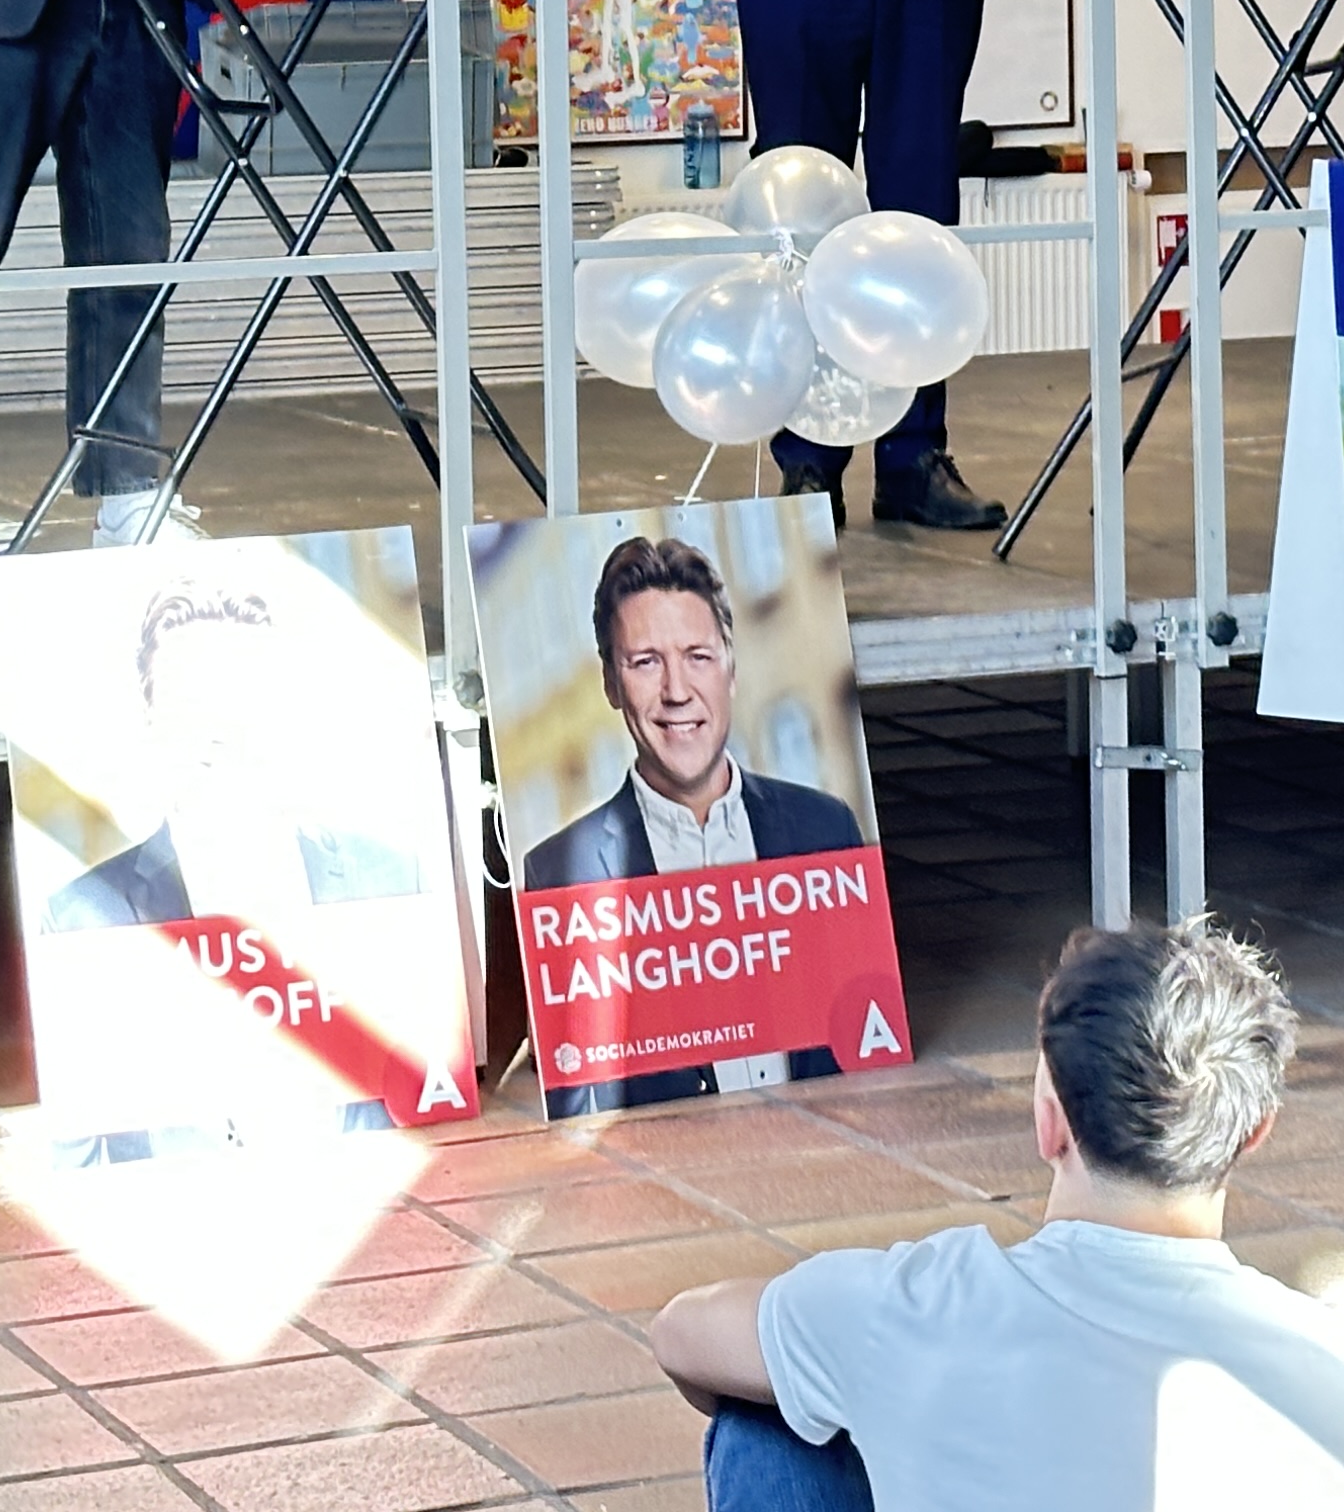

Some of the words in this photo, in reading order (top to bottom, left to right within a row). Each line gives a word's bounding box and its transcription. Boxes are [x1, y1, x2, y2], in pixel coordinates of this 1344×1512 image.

[531, 884, 722, 949] RASMUS
[732, 863, 869, 921] HORN
[540, 928, 792, 1005] LANGHOFF
[585, 1022, 756, 1064] SOCIALDEMOKRATIET
[859, 999, 902, 1058] A
[417, 1055, 467, 1113] A
